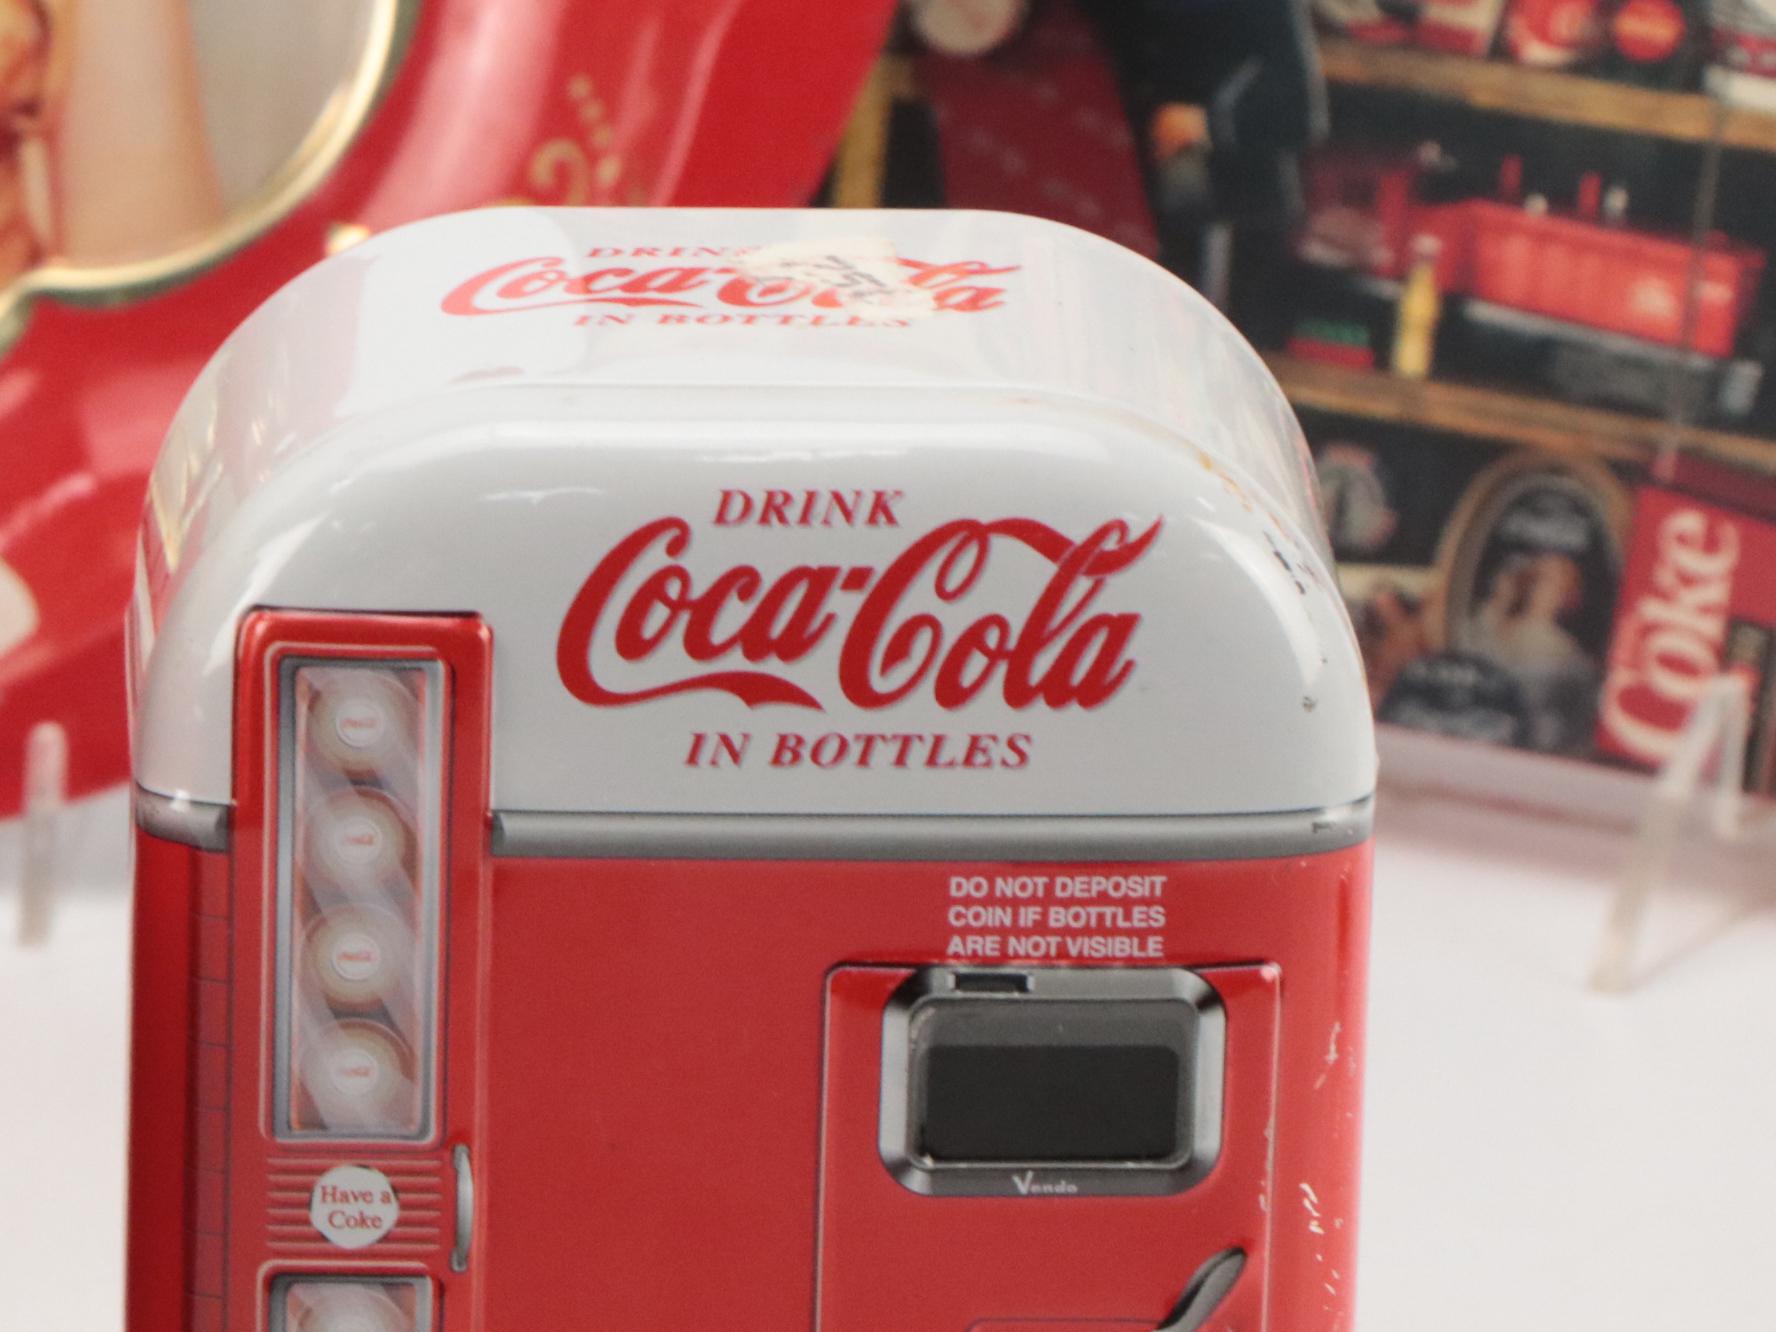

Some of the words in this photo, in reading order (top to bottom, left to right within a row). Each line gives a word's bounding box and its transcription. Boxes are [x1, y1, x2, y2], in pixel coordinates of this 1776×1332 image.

[713, 488, 906, 528] DRINK
[556, 515, 1164, 711] Coca-Cola
[685, 731, 750, 768] IN
[769, 732, 1031, 770] BOTTLES
[949, 876, 989, 898] DO
[995, 876, 1048, 899] NOT
[1055, 876, 1167, 899] DEPOSIT
[948, 905, 1012, 928] COIN
[1018, 905, 1042, 928] IF
[1048, 905, 1166, 929] BOTTLES
[946, 935, 1000, 957] ARE
[1007, 935, 1061, 958] NOT
[1064, 935, 1164, 958] VISIBLE
[320, 1185, 373, 1205] Have
[380, 1189, 391, 1204] a
[328, 1209, 382, 1230] Coke
